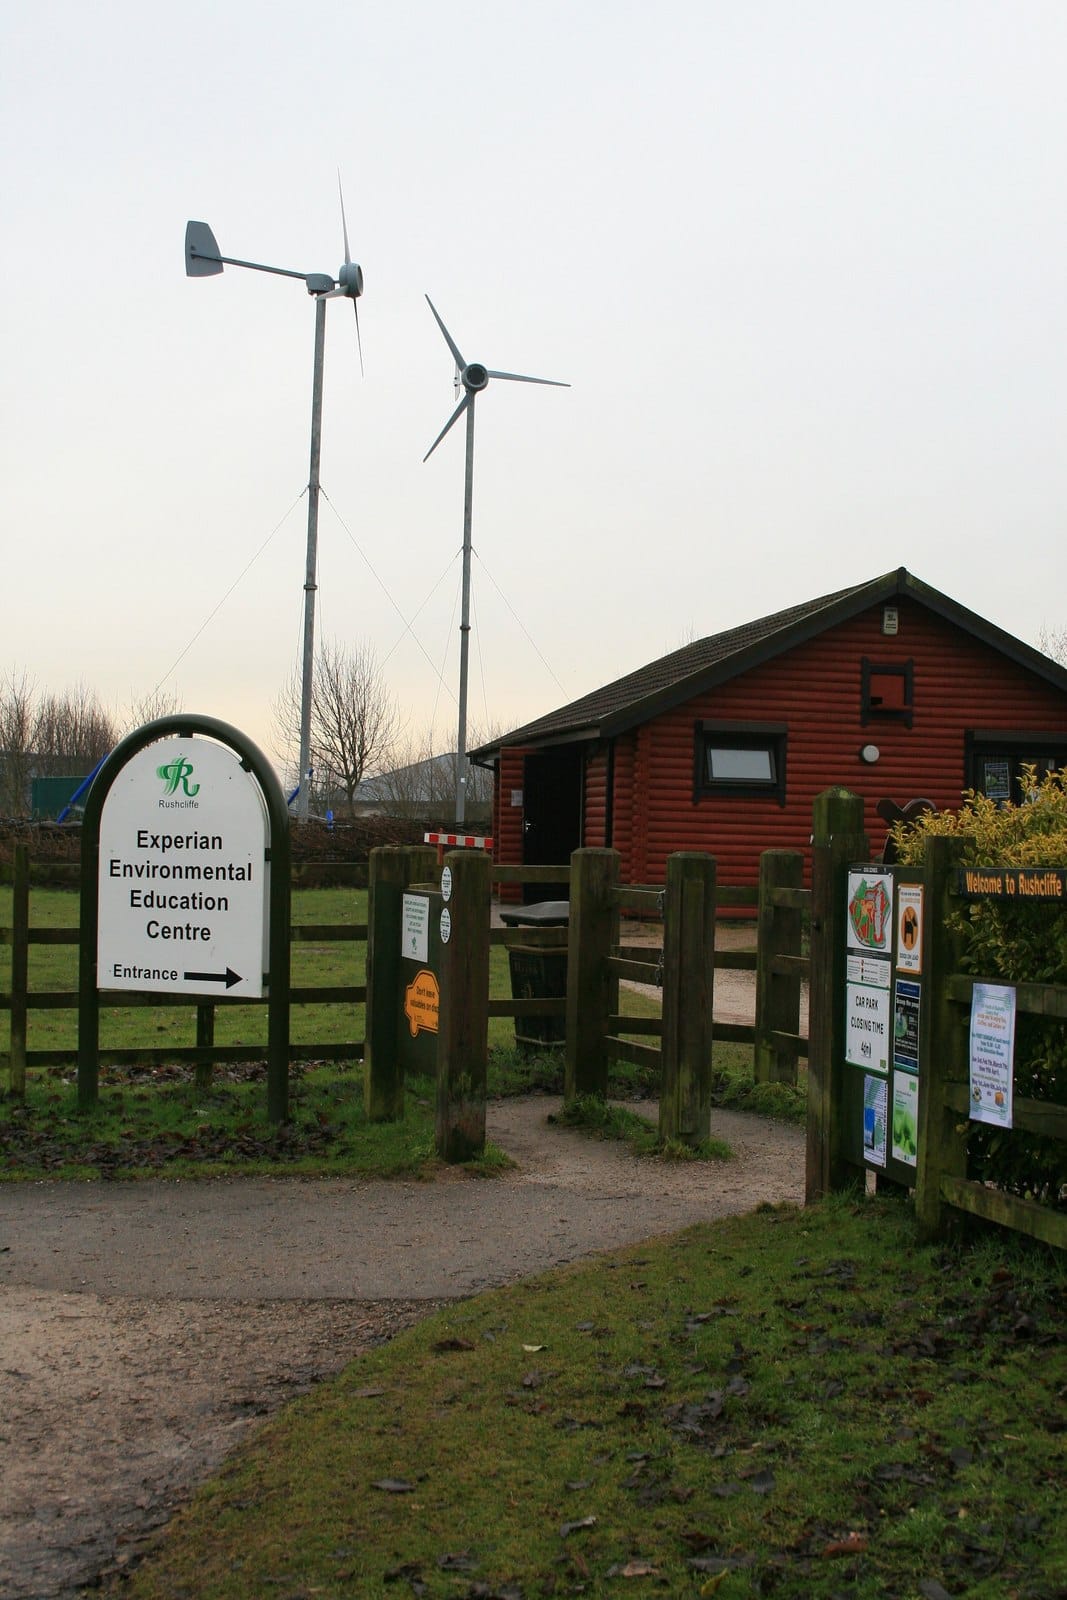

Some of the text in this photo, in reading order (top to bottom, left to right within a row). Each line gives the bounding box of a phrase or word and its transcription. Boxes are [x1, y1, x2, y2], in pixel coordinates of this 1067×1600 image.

[158, 799, 199, 809] Rushcliffe
[137, 830, 223, 853] Experian
[109, 860, 252, 881] Environmental
[966, 872, 1062, 897] Welcome to Rushcliffe
[130, 890, 229, 911] Education
[146, 920, 211, 941] Centre
[113, 964, 178, 981] Entrance
[855, 995, 879, 1011] CAR PARK
[850, 1016, 884, 1035] CLOSING TIME
